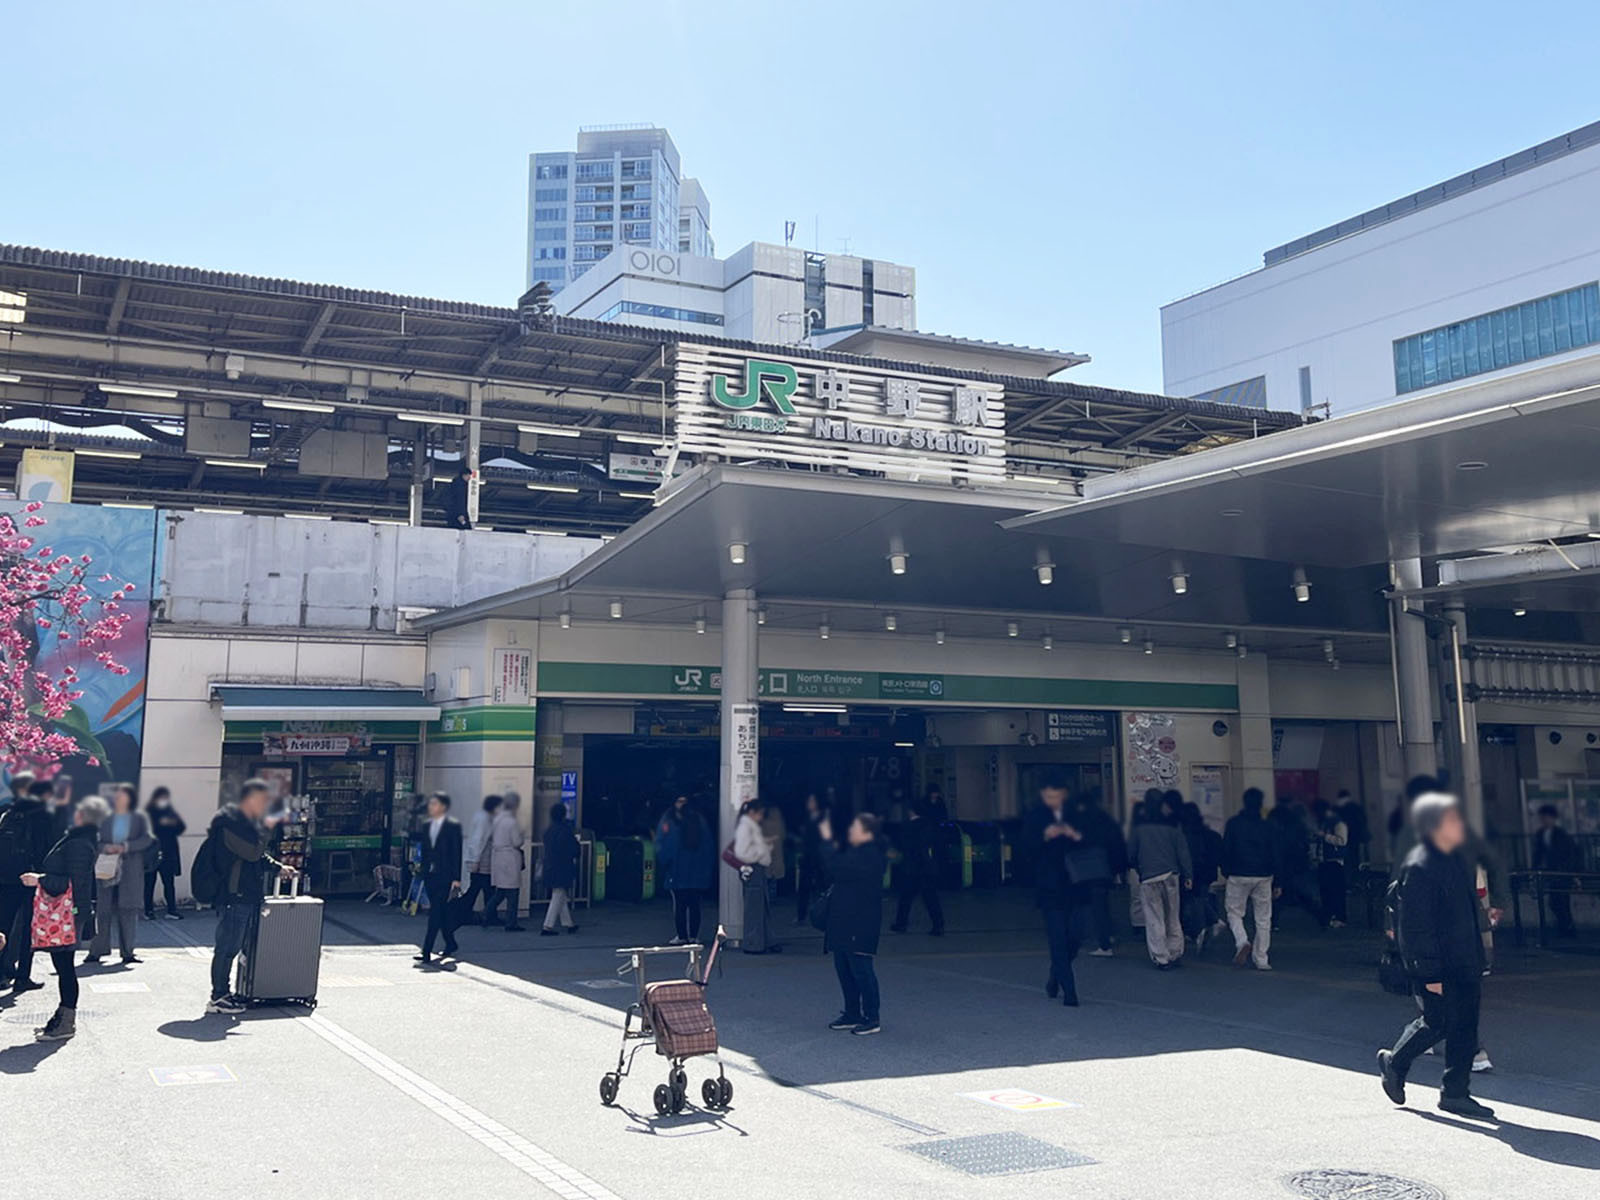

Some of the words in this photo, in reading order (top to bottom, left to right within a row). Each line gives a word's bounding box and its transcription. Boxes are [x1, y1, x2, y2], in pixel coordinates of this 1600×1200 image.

[711, 357, 799, 416] JR
[815, 368, 989, 429] 中野駅
[726, 413, 788, 434] JR東日本
[814, 417, 902, 446] Nakano
[910, 428, 990, 456] Station
[674, 669, 703, 686] JR
[796, 672, 822, 684] North
[824, 673, 864, 686] Entrance
[562, 772, 577, 785] TV
